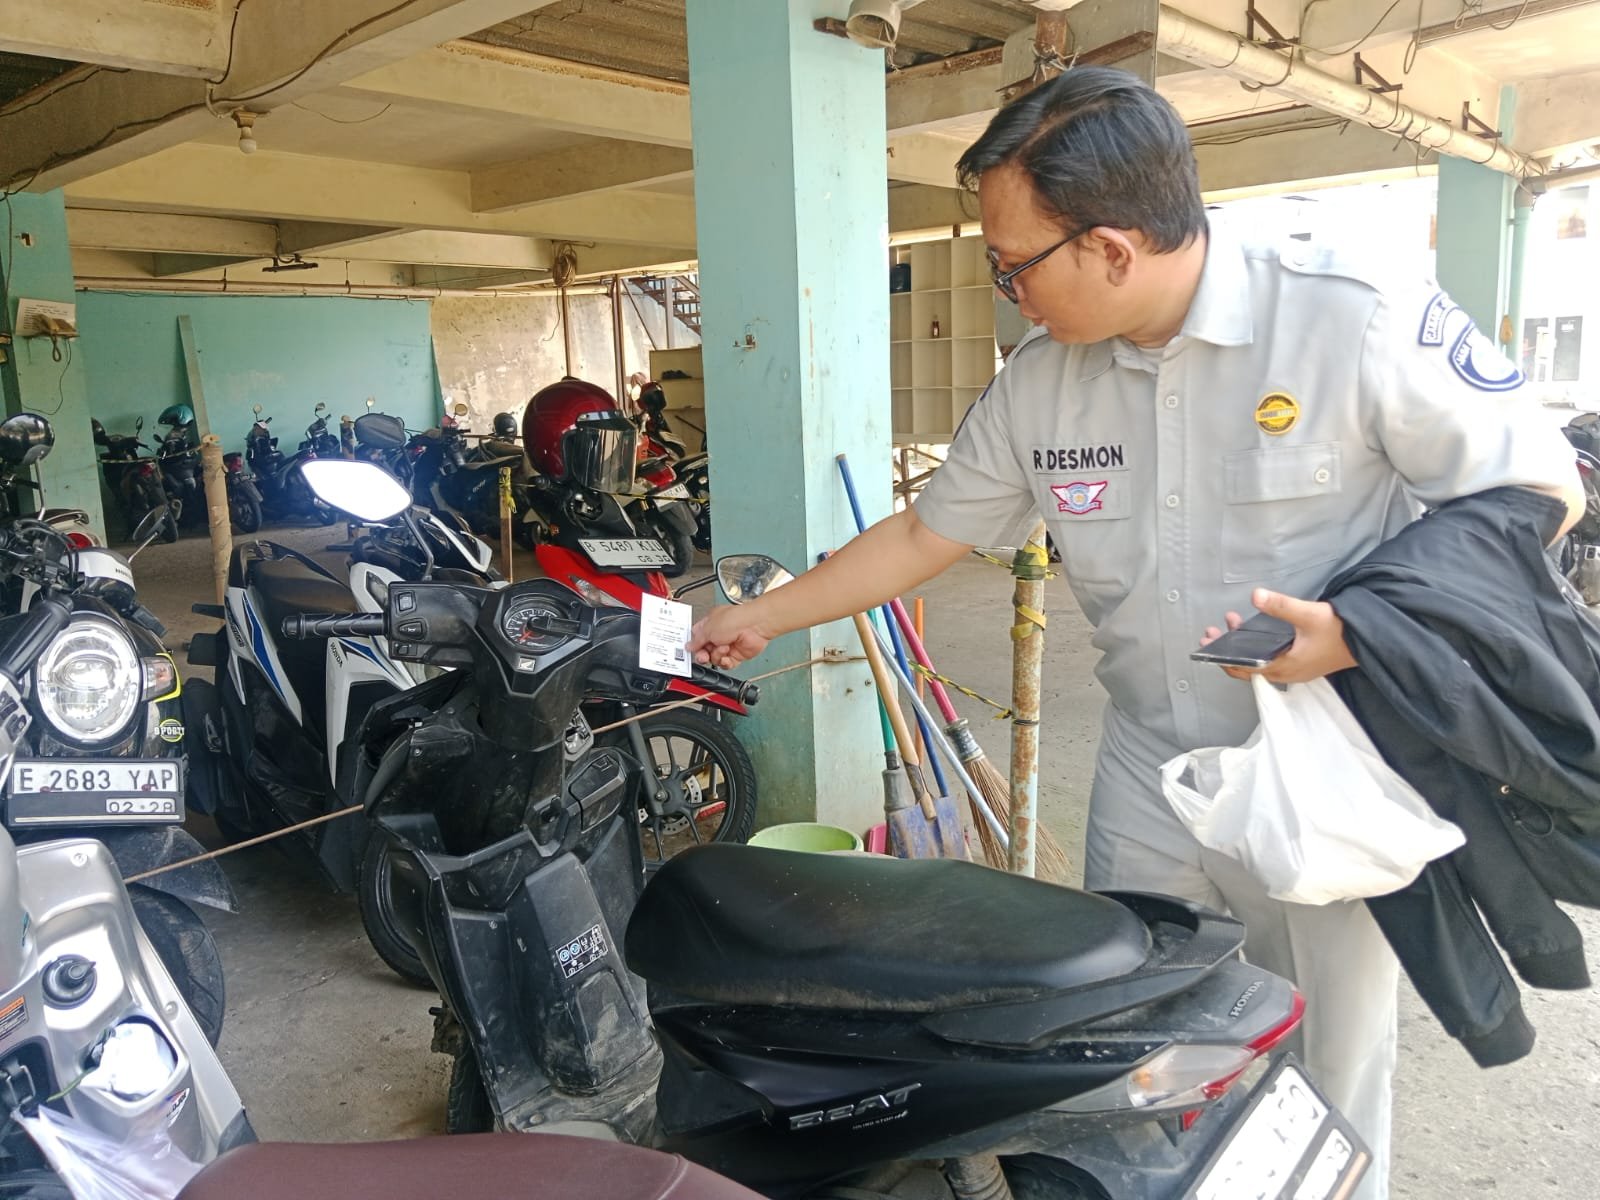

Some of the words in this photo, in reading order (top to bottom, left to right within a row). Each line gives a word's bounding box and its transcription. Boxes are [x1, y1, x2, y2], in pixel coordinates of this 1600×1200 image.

[1033, 449, 1043, 470] R
[1046, 444, 1124, 470] DESMON
[584, 541, 596, 553] B
[20, 768, 33, 791] E
[50, 768, 112, 791] 2683
[128, 769, 173, 790] YAP
[1230, 981, 1264, 1017] HONDA
[789, 1083, 922, 1130] BEAT
